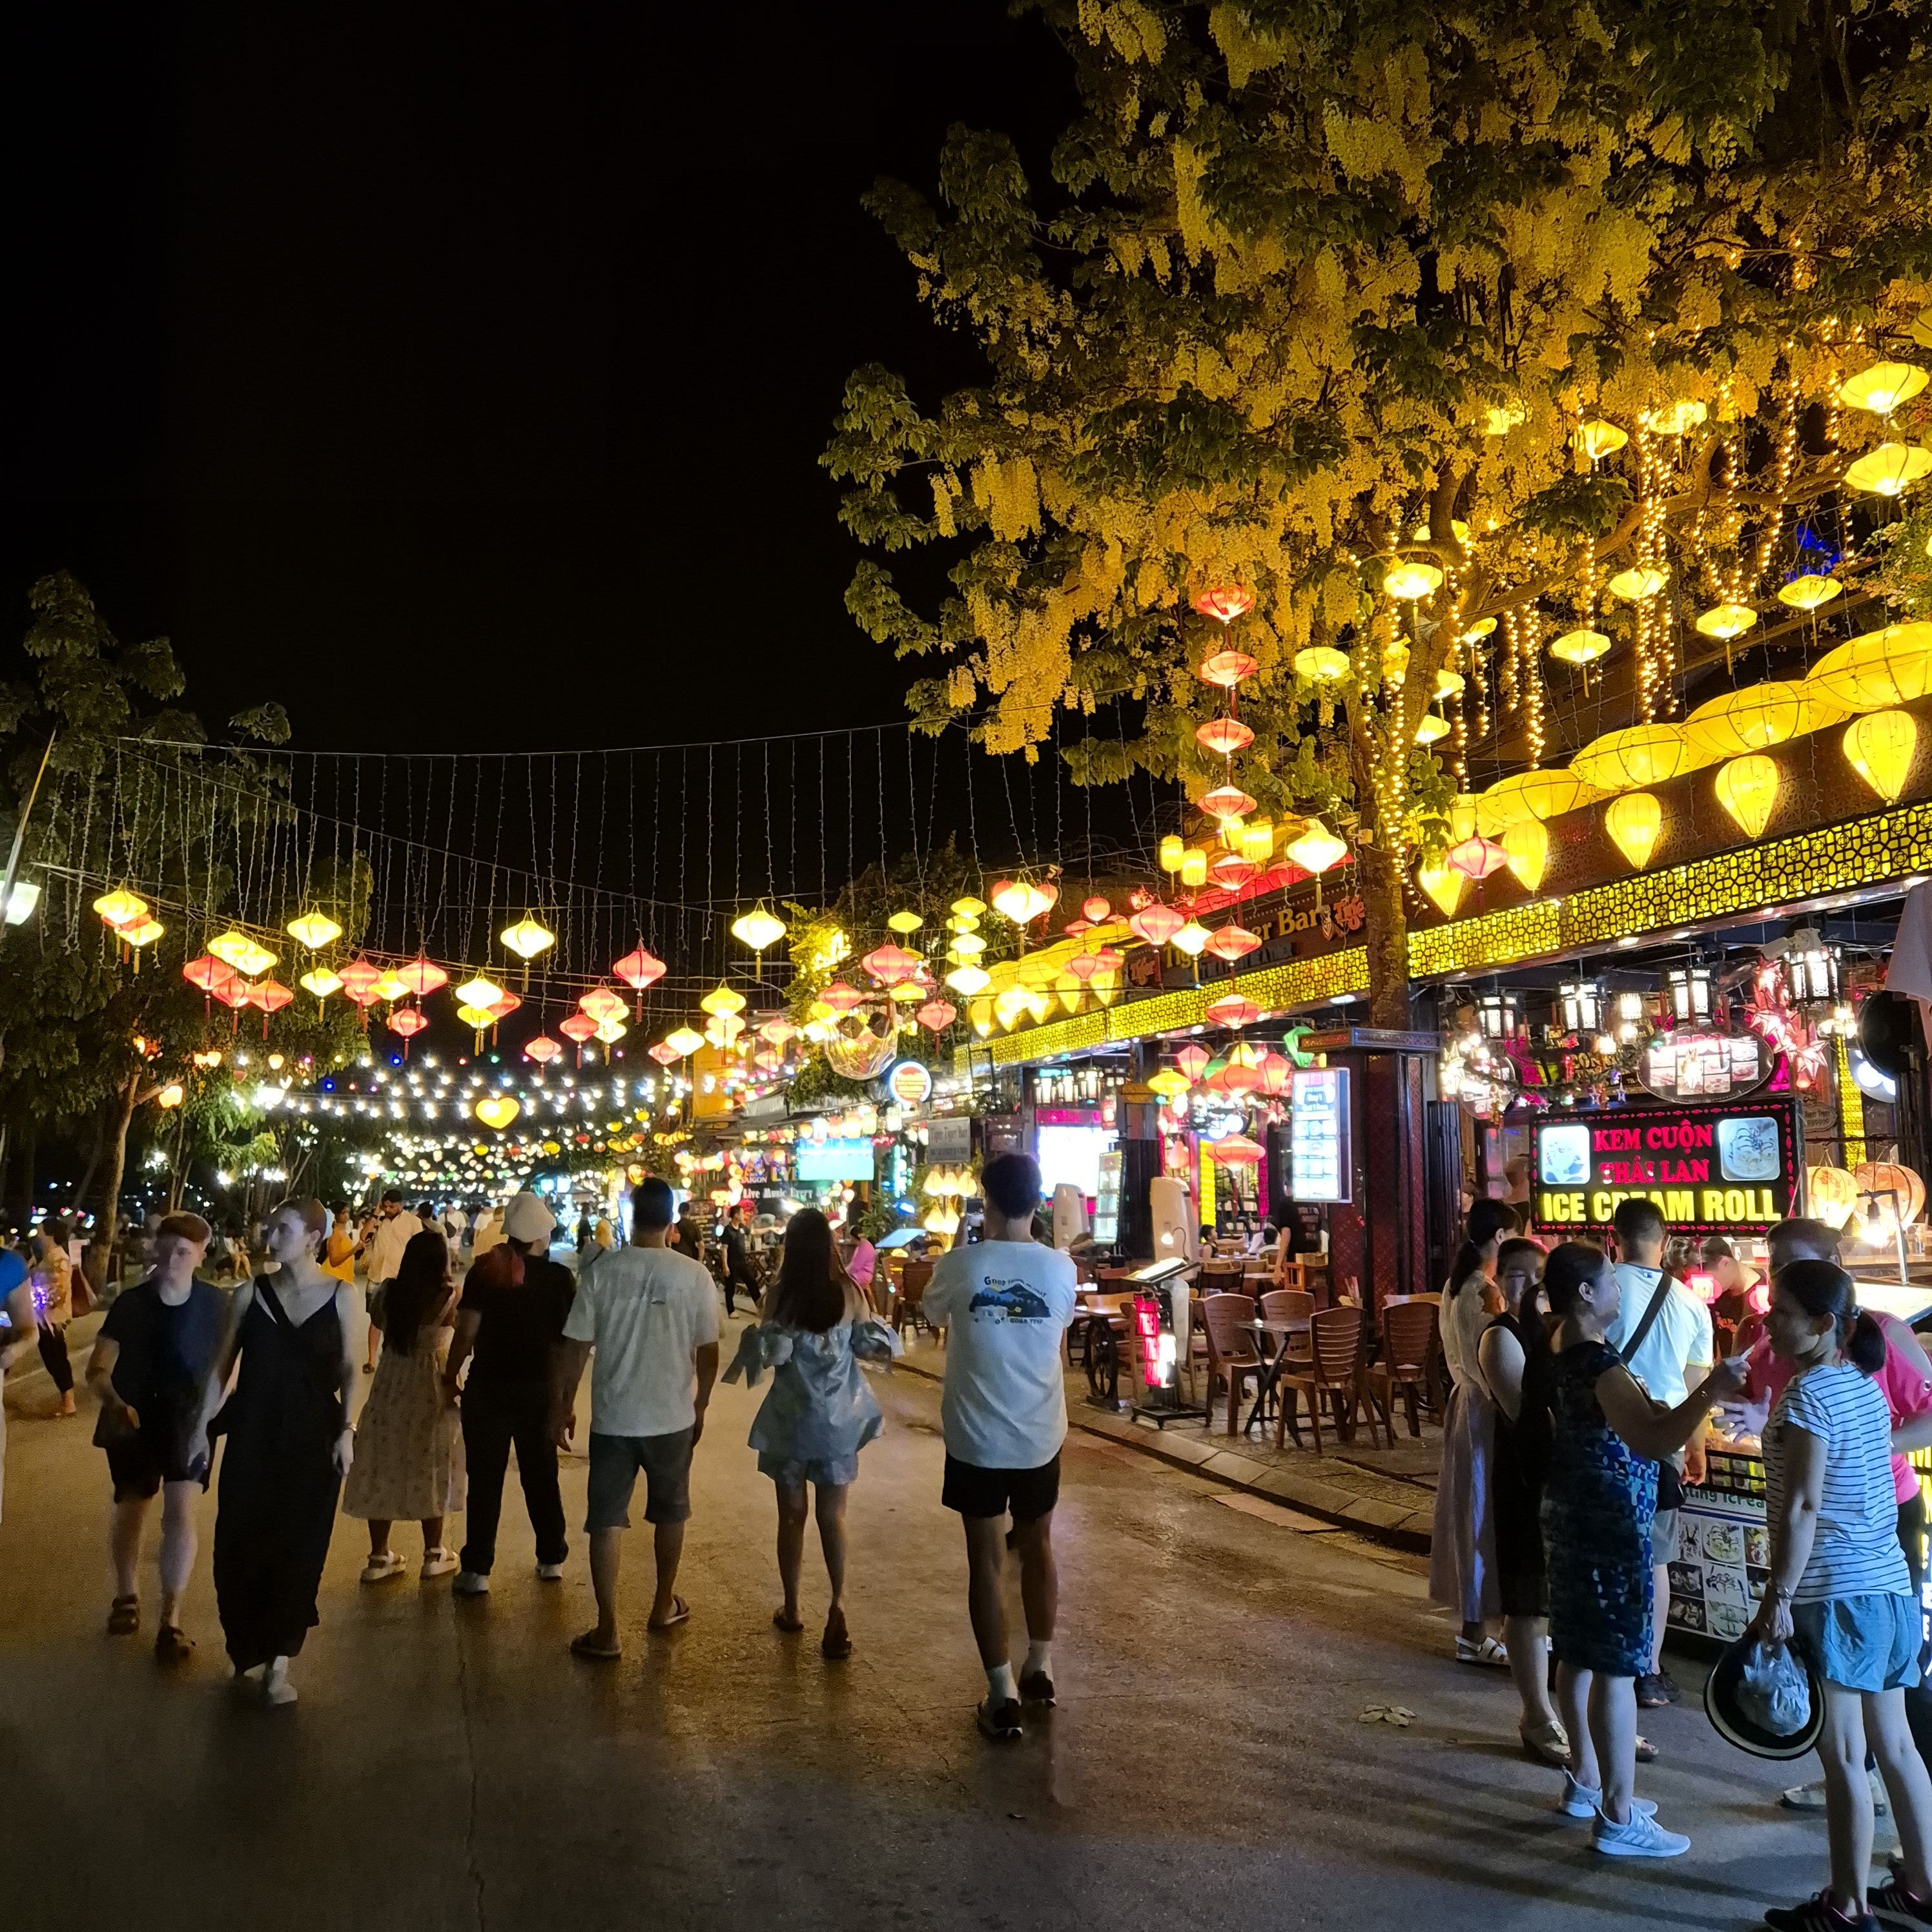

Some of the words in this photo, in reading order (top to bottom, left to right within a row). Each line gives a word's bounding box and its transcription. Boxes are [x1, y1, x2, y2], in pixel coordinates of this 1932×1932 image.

[1277, 908, 1319, 936] Bar
[1593, 1128, 1641, 1152] KEM
[1646, 1119, 1714, 1155] CUỘN
[1598, 1155, 1656, 1185] THÁI
[1660, 1158, 1710, 1184] LAN
[1543, 1192, 1587, 1222] ICE
[1592, 1190, 1696, 1222] CAM
[1703, 1189, 1782, 1221] ROLL
